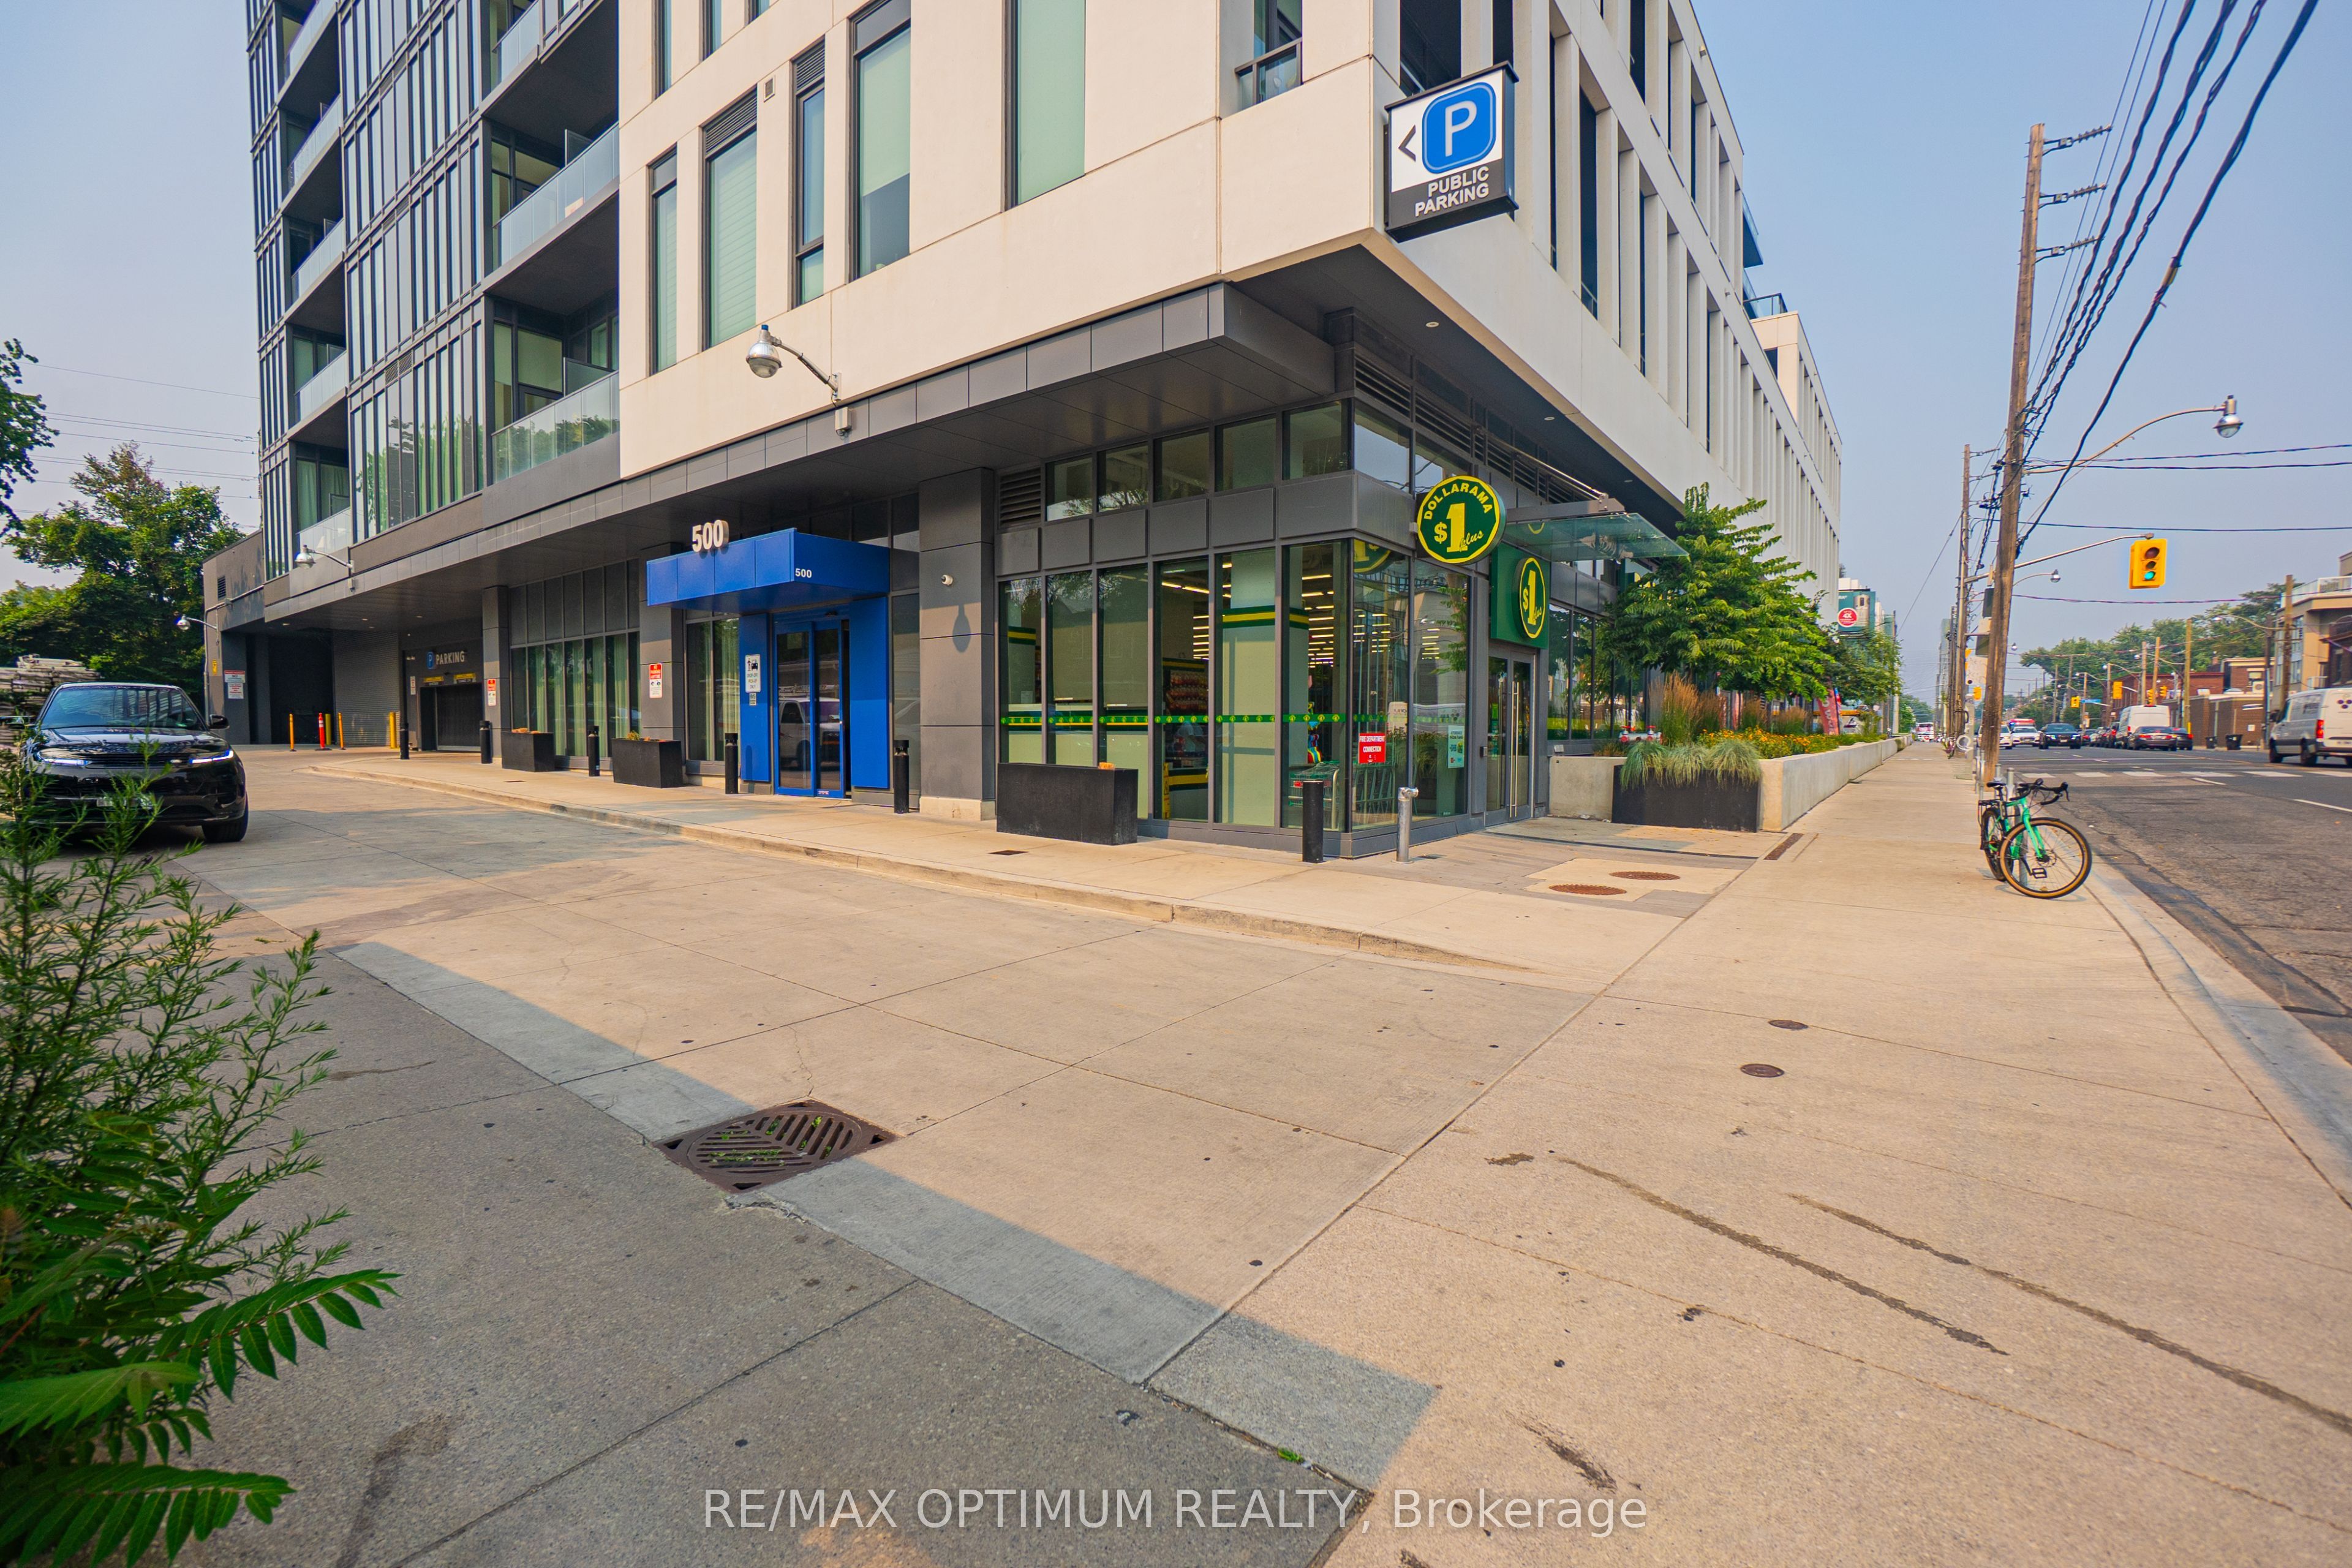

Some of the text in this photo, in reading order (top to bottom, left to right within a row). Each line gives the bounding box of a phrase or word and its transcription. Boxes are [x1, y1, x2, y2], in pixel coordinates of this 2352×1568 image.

[1445, 100, 1477, 157] P
[1428, 166, 1489, 197] PUBLIC
[1415, 183, 1489, 217] PARKING
[1423, 482, 1493, 521] DOLLARAMA
[692, 519, 724, 552] 500
[1434, 503, 1468, 552] $1
[1460, 530, 1483, 552] plus
[795, 568, 812, 578] 500
[435, 650, 466, 665] PARKING
